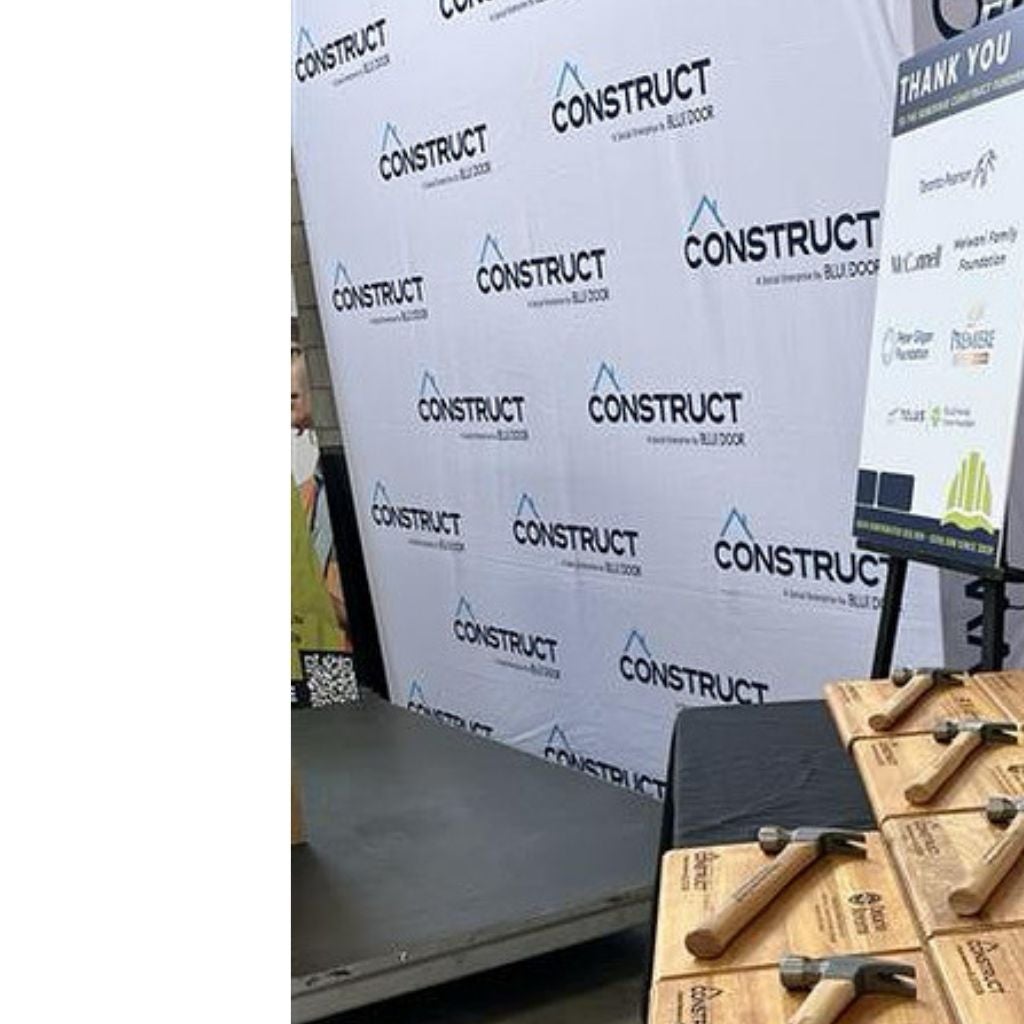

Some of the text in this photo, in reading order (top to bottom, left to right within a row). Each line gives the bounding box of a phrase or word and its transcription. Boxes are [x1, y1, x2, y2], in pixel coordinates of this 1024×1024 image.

[295, 19, 387, 83] CONSTRUCT
[900, 29, 1011, 105] THANK YOU
[552, 57, 711, 133] CONSTRUCT
[379, 124, 487, 182] CONSTRUCT
[684, 210, 881, 269] CONSTRUCT
[332, 276, 423, 312] CONSTRUCT
[477, 248, 605, 294] CONSTRUCT
[418, 396, 525, 424] CONSTRUCT
[589, 392, 742, 425] CONSTRUCT
[372, 504, 461, 535] CONSTRUCT
[513, 520, 638, 557] CONSTRUCT
[453, 618, 558, 664] CONSTRUCT
[620, 655, 769, 705] CONSTRUCT
